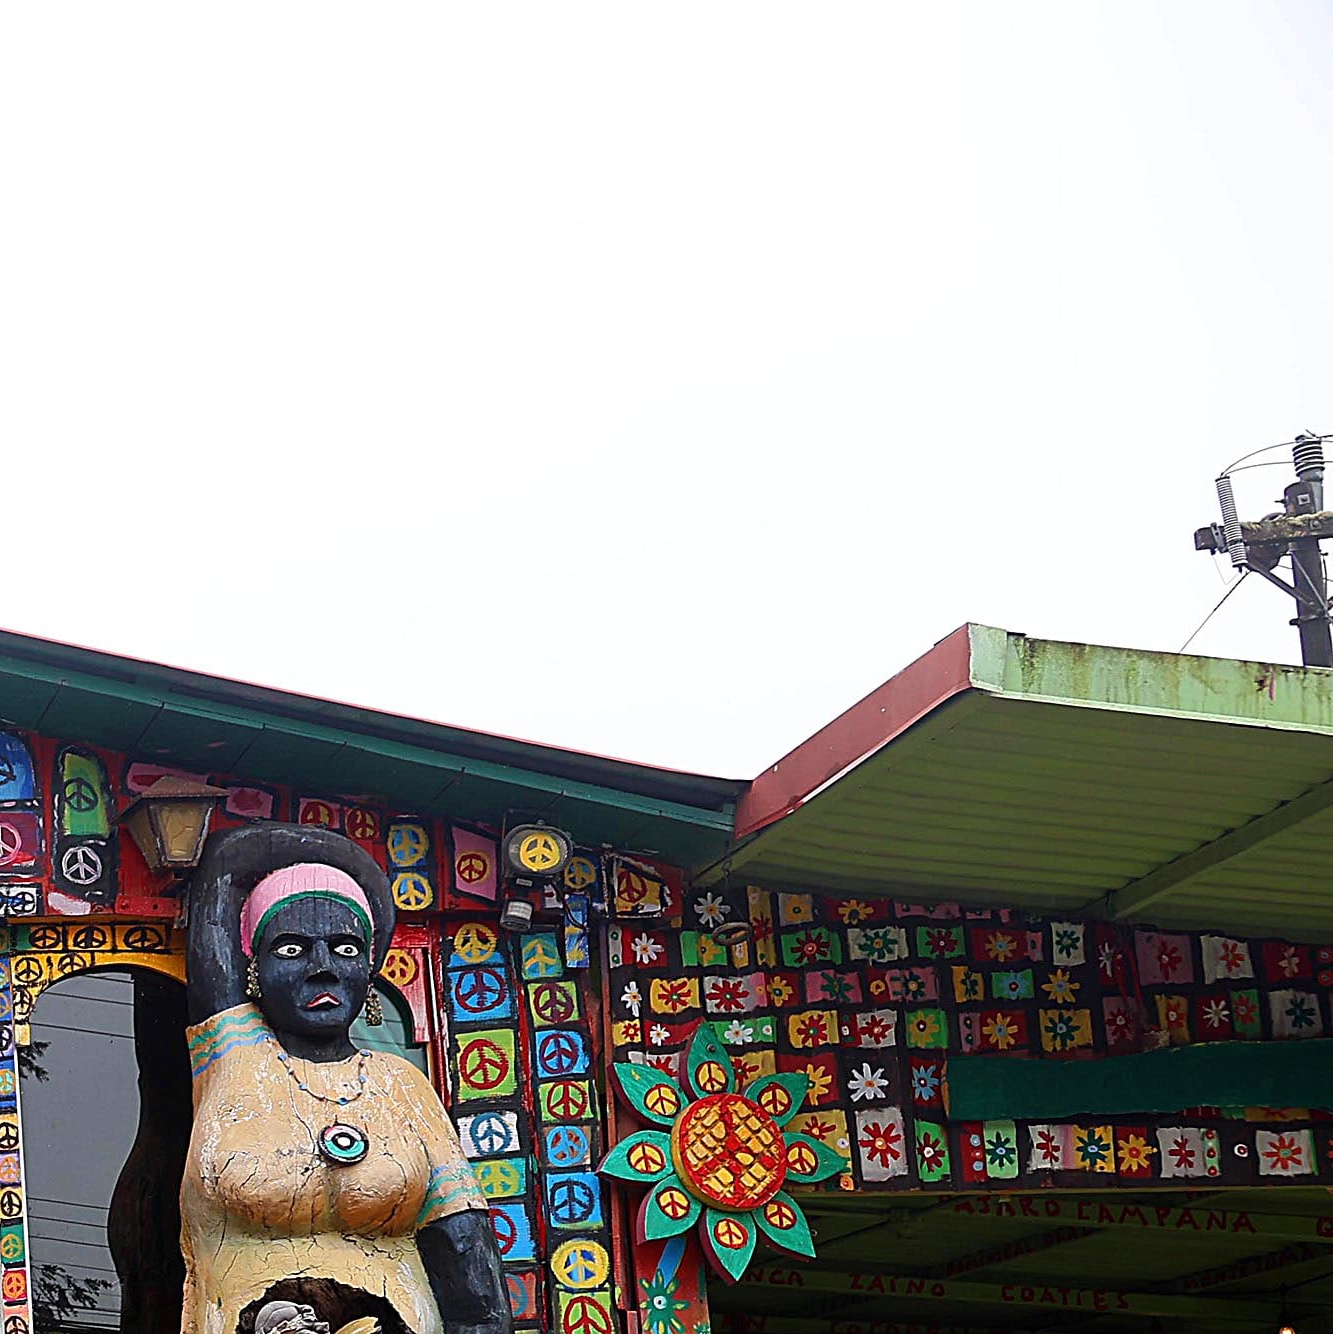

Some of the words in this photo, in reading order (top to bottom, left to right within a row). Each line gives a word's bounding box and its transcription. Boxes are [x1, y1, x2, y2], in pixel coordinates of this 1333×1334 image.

[1077, 1201, 1257, 1234] CAMPANA
[849, 1273, 946, 1297] ZAINO
[1000, 1285, 1130, 1311] COATIES
